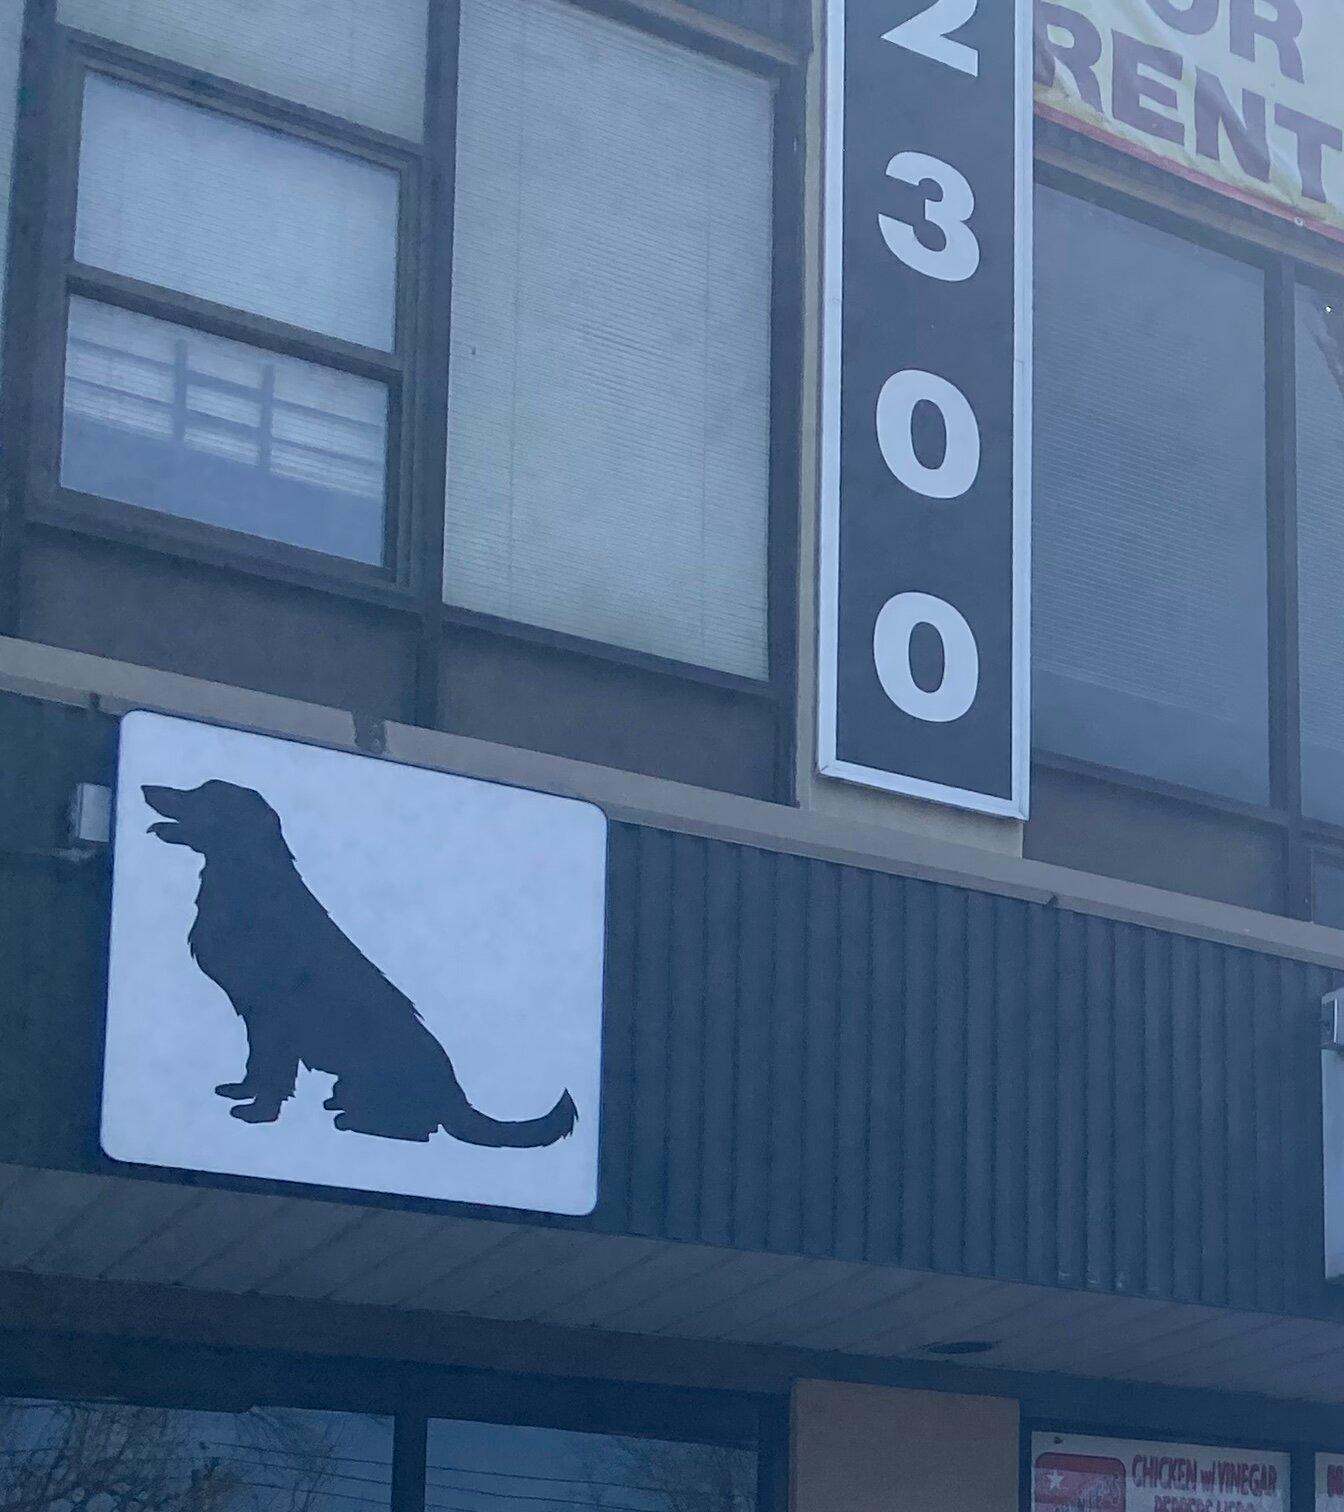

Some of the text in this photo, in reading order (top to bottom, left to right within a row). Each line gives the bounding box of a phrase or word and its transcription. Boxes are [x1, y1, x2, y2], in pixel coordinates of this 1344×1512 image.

[1034, 3, 1342, 203] RENT
[1132, 1454, 1198, 1492] CHICKEN
[1217, 1460, 1278, 1497] VINEGAR
